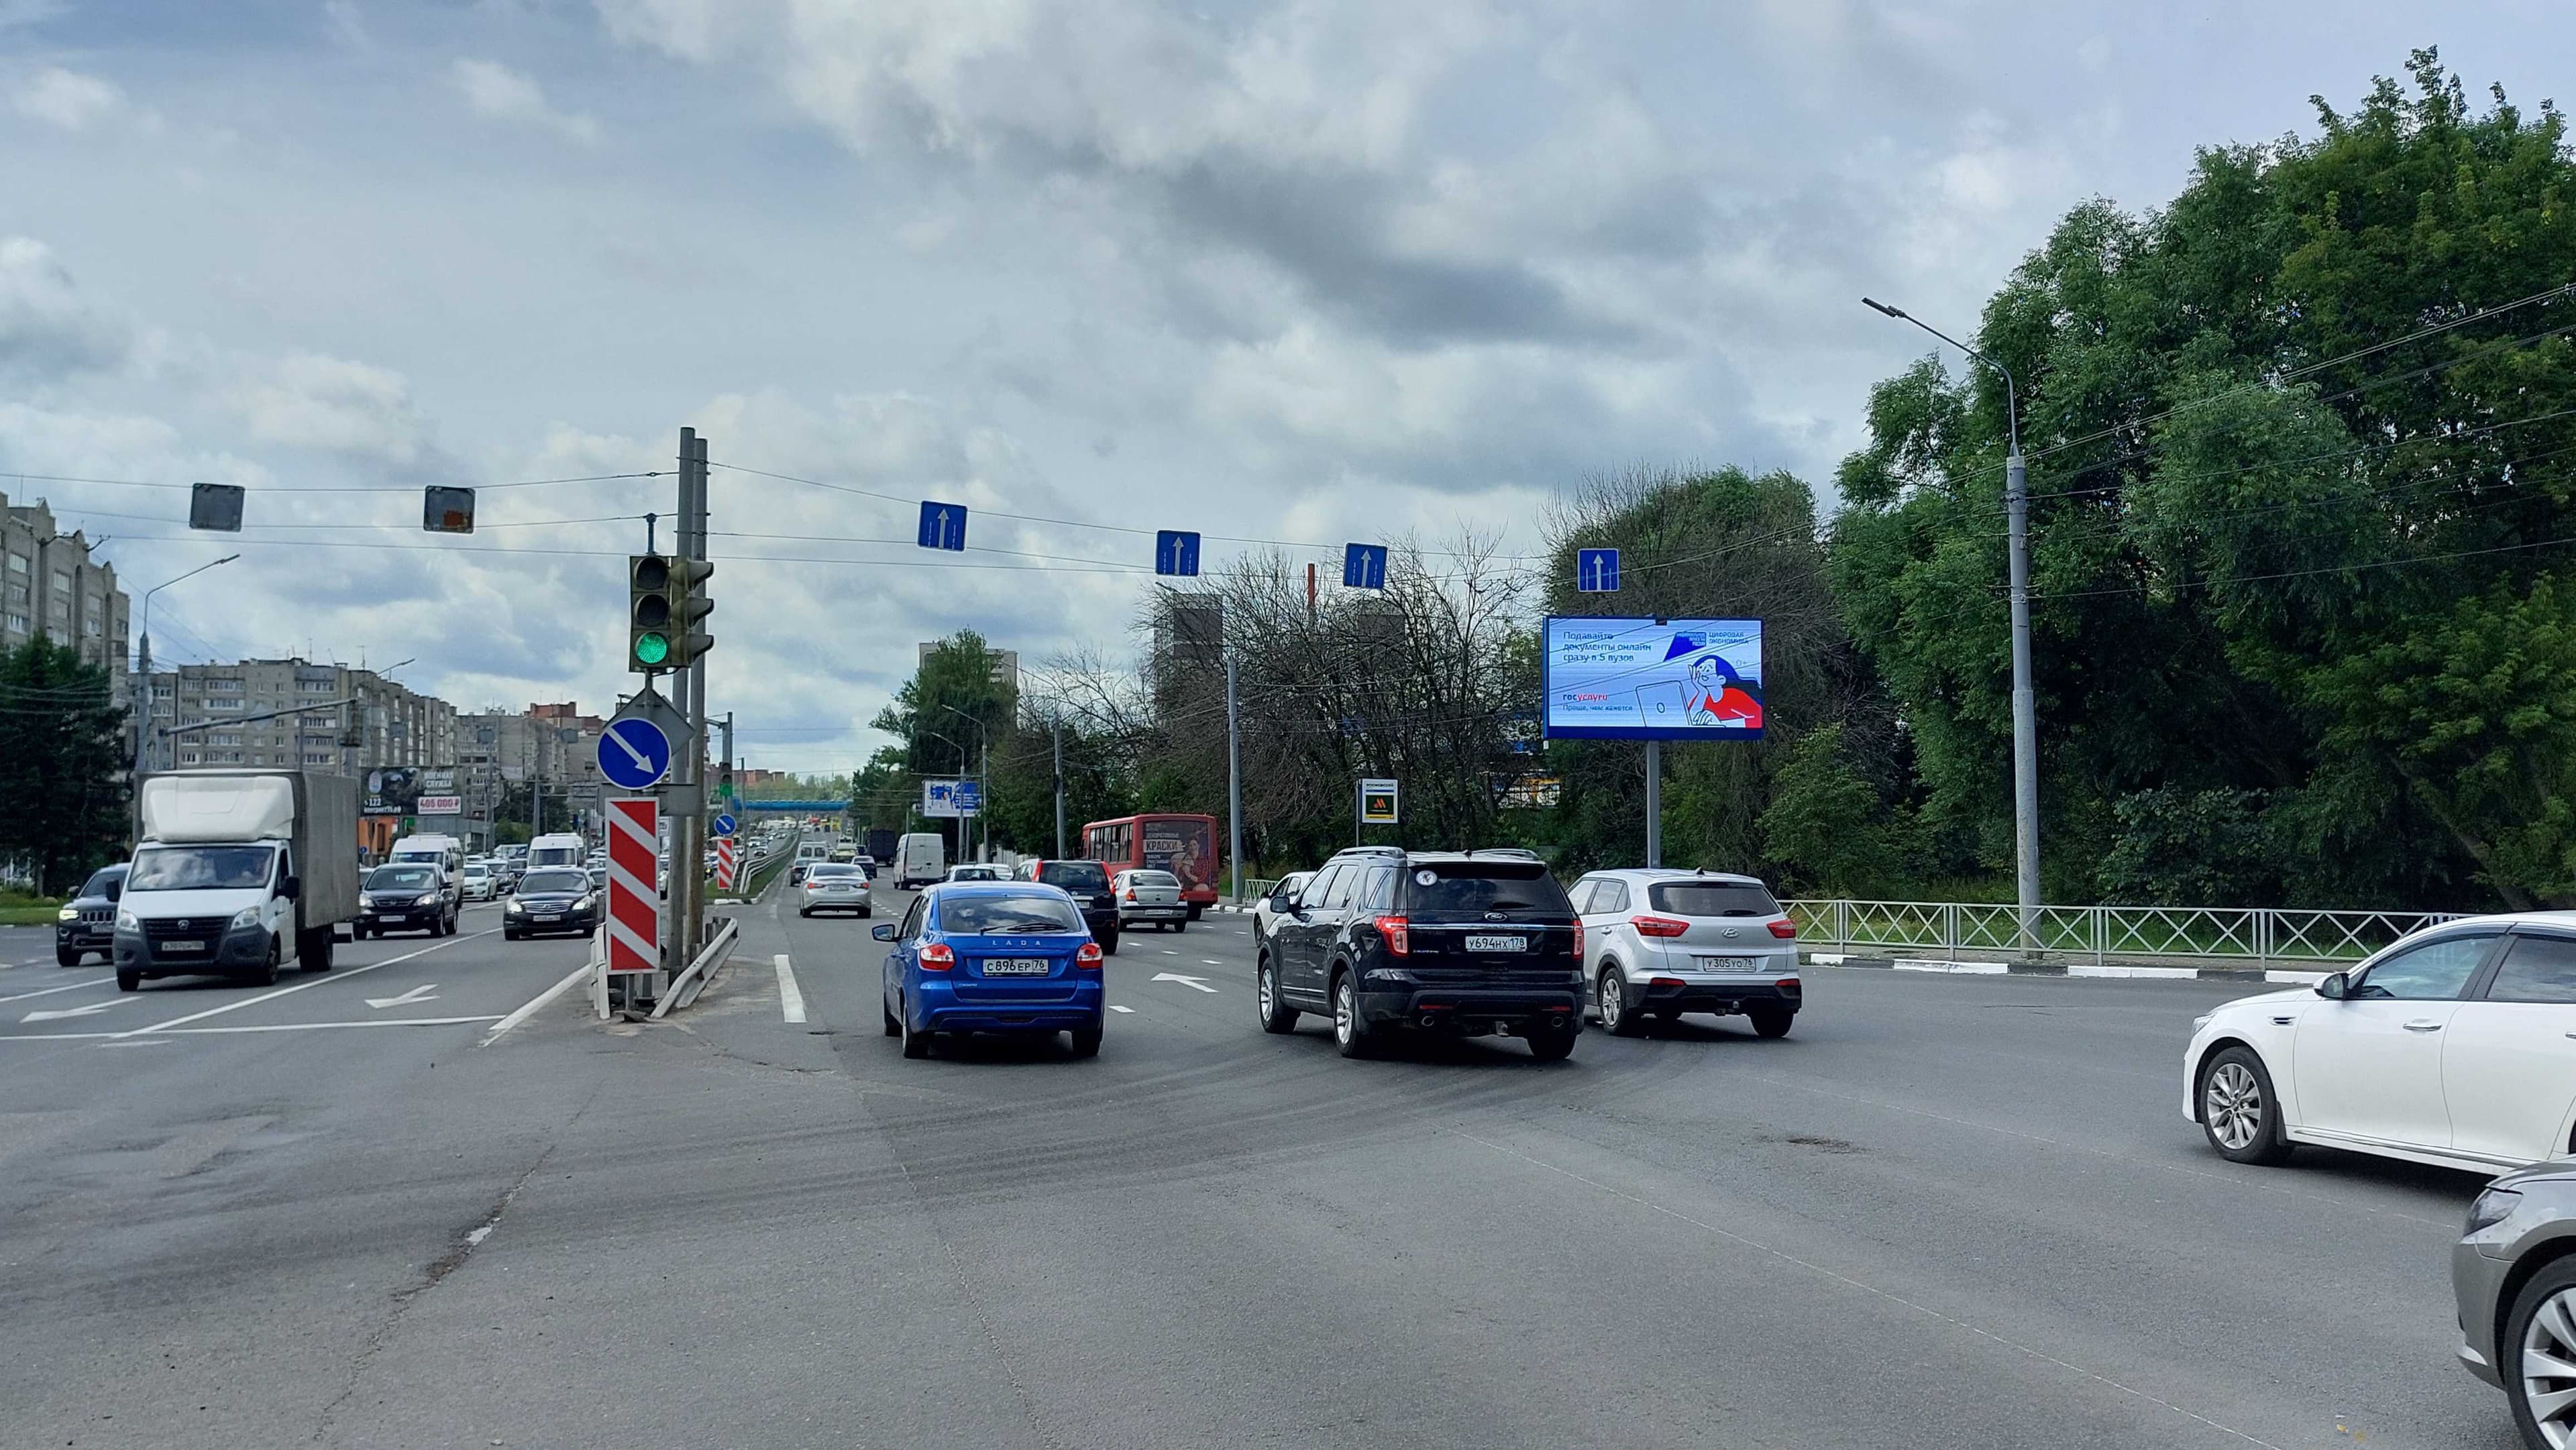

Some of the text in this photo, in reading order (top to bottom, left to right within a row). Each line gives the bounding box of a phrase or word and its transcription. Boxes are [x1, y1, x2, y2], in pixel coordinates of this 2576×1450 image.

[1563, 631, 1613, 640] Подавайте
[1564, 644, 1615, 653] документы
[1563, 654, 1589, 663] сразу
[1599, 653, 1605, 661] 5
[1608, 655, 1634, 663] вузов
[1563, 694, 1608, 703] госуслуги
[437, 799, 453, 807] 000
[1146, 840, 1179, 851] КРАСКИ
